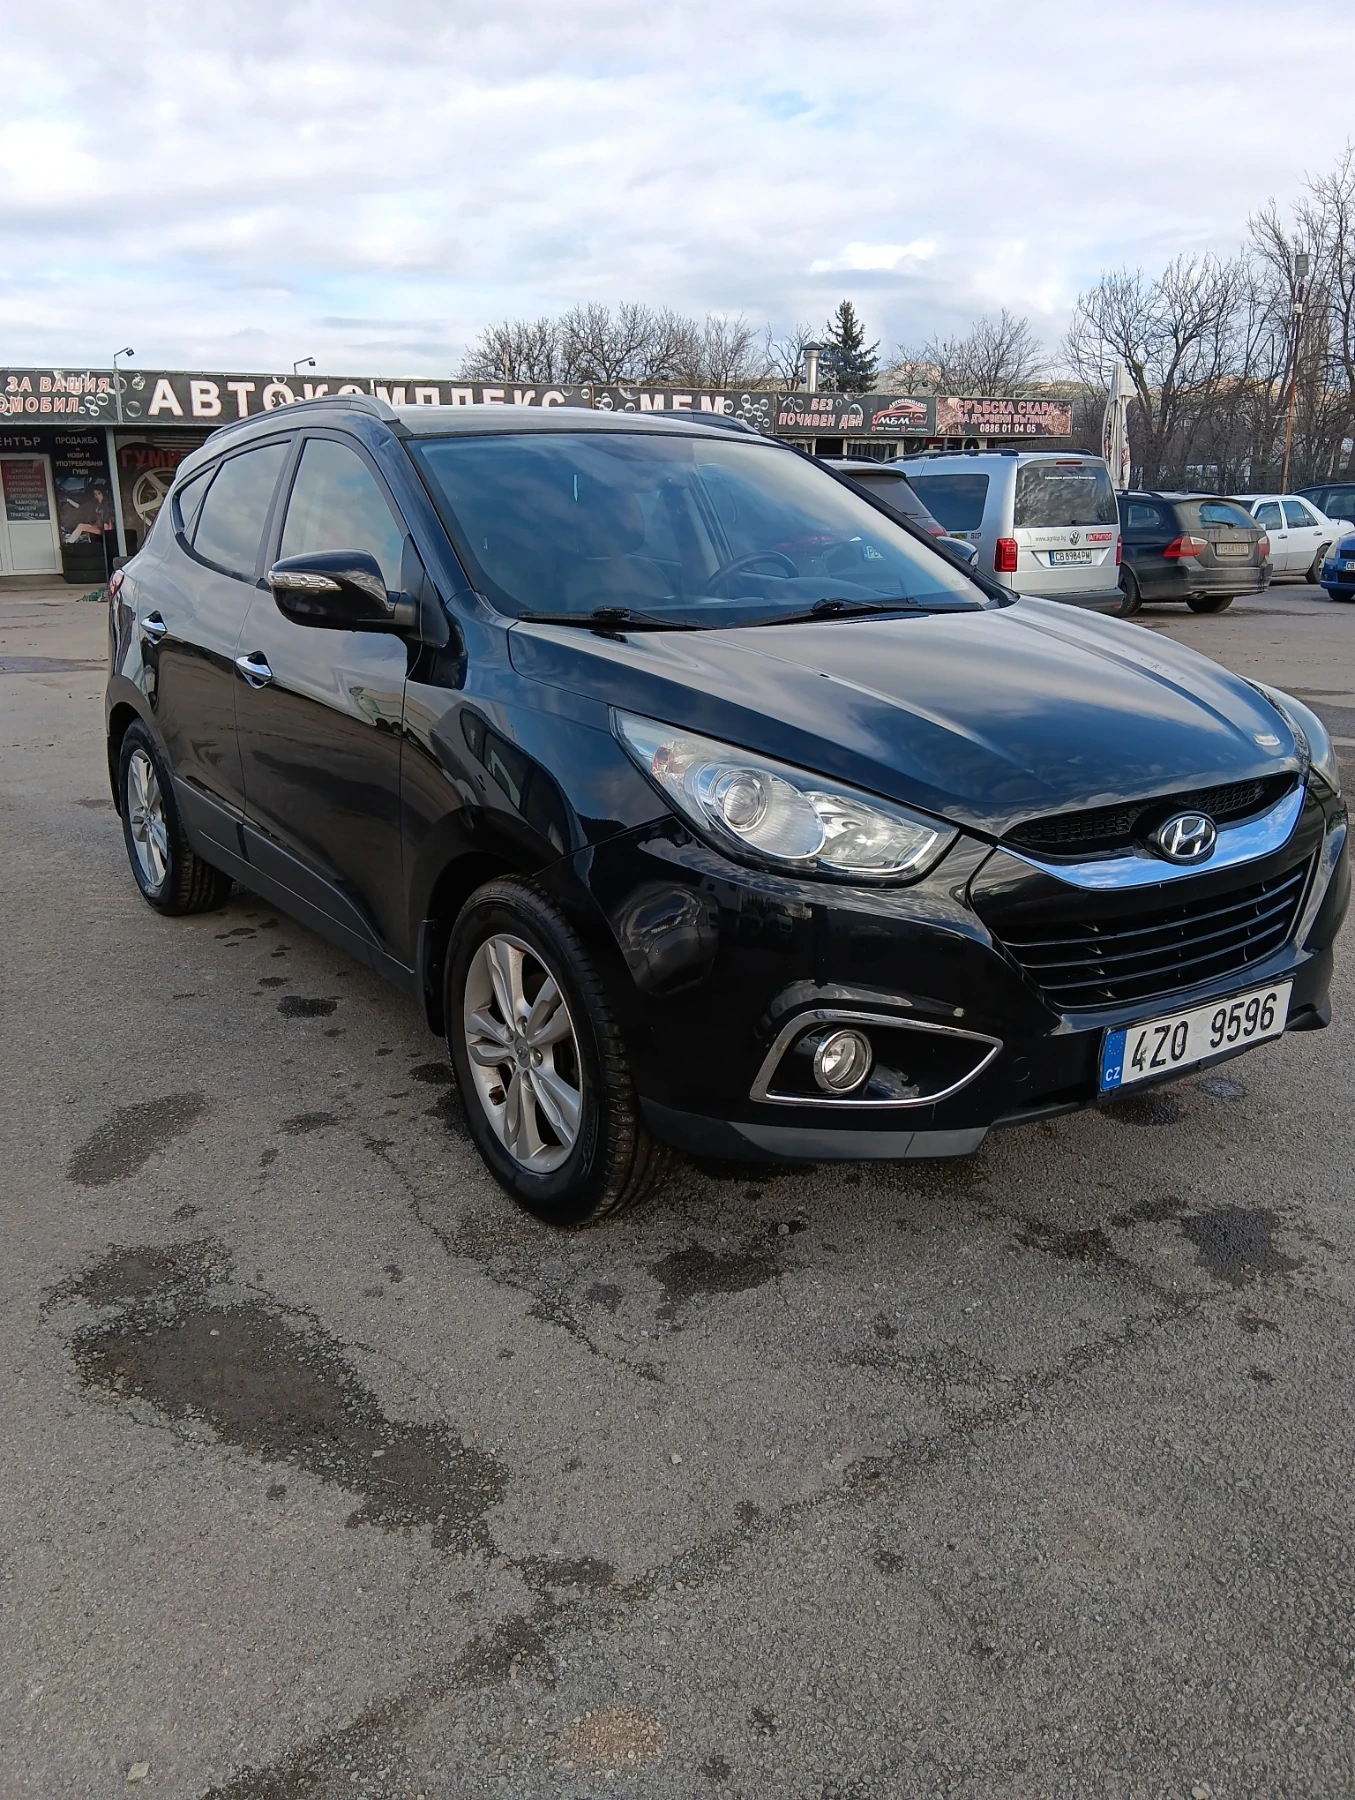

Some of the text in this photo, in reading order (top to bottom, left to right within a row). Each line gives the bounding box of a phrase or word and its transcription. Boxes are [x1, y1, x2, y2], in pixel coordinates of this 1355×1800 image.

[7, 376, 110, 393] ЗА ВАШИЯ
[148, 379, 566, 417] АВТОМПЛЕКС
[810, 398, 834, 411] БЕЗ
[955, 400, 1055, 415] СРЪБСКА СКАРА
[778, 412, 863, 430] ПОЧИВЕН ДЕН
[878, 416, 910, 425] МБМ
[979, 423, 1037, 433] 0886 01 04 05
[55, 436, 98, 445] ПРОДАЖБА
[1090, 533, 1112, 541] АГРИТОП
[1055, 552, 1065, 561] CB
[1209, 992, 1278, 1049] 9596
[1105, 1066, 1121, 1082] CZ
